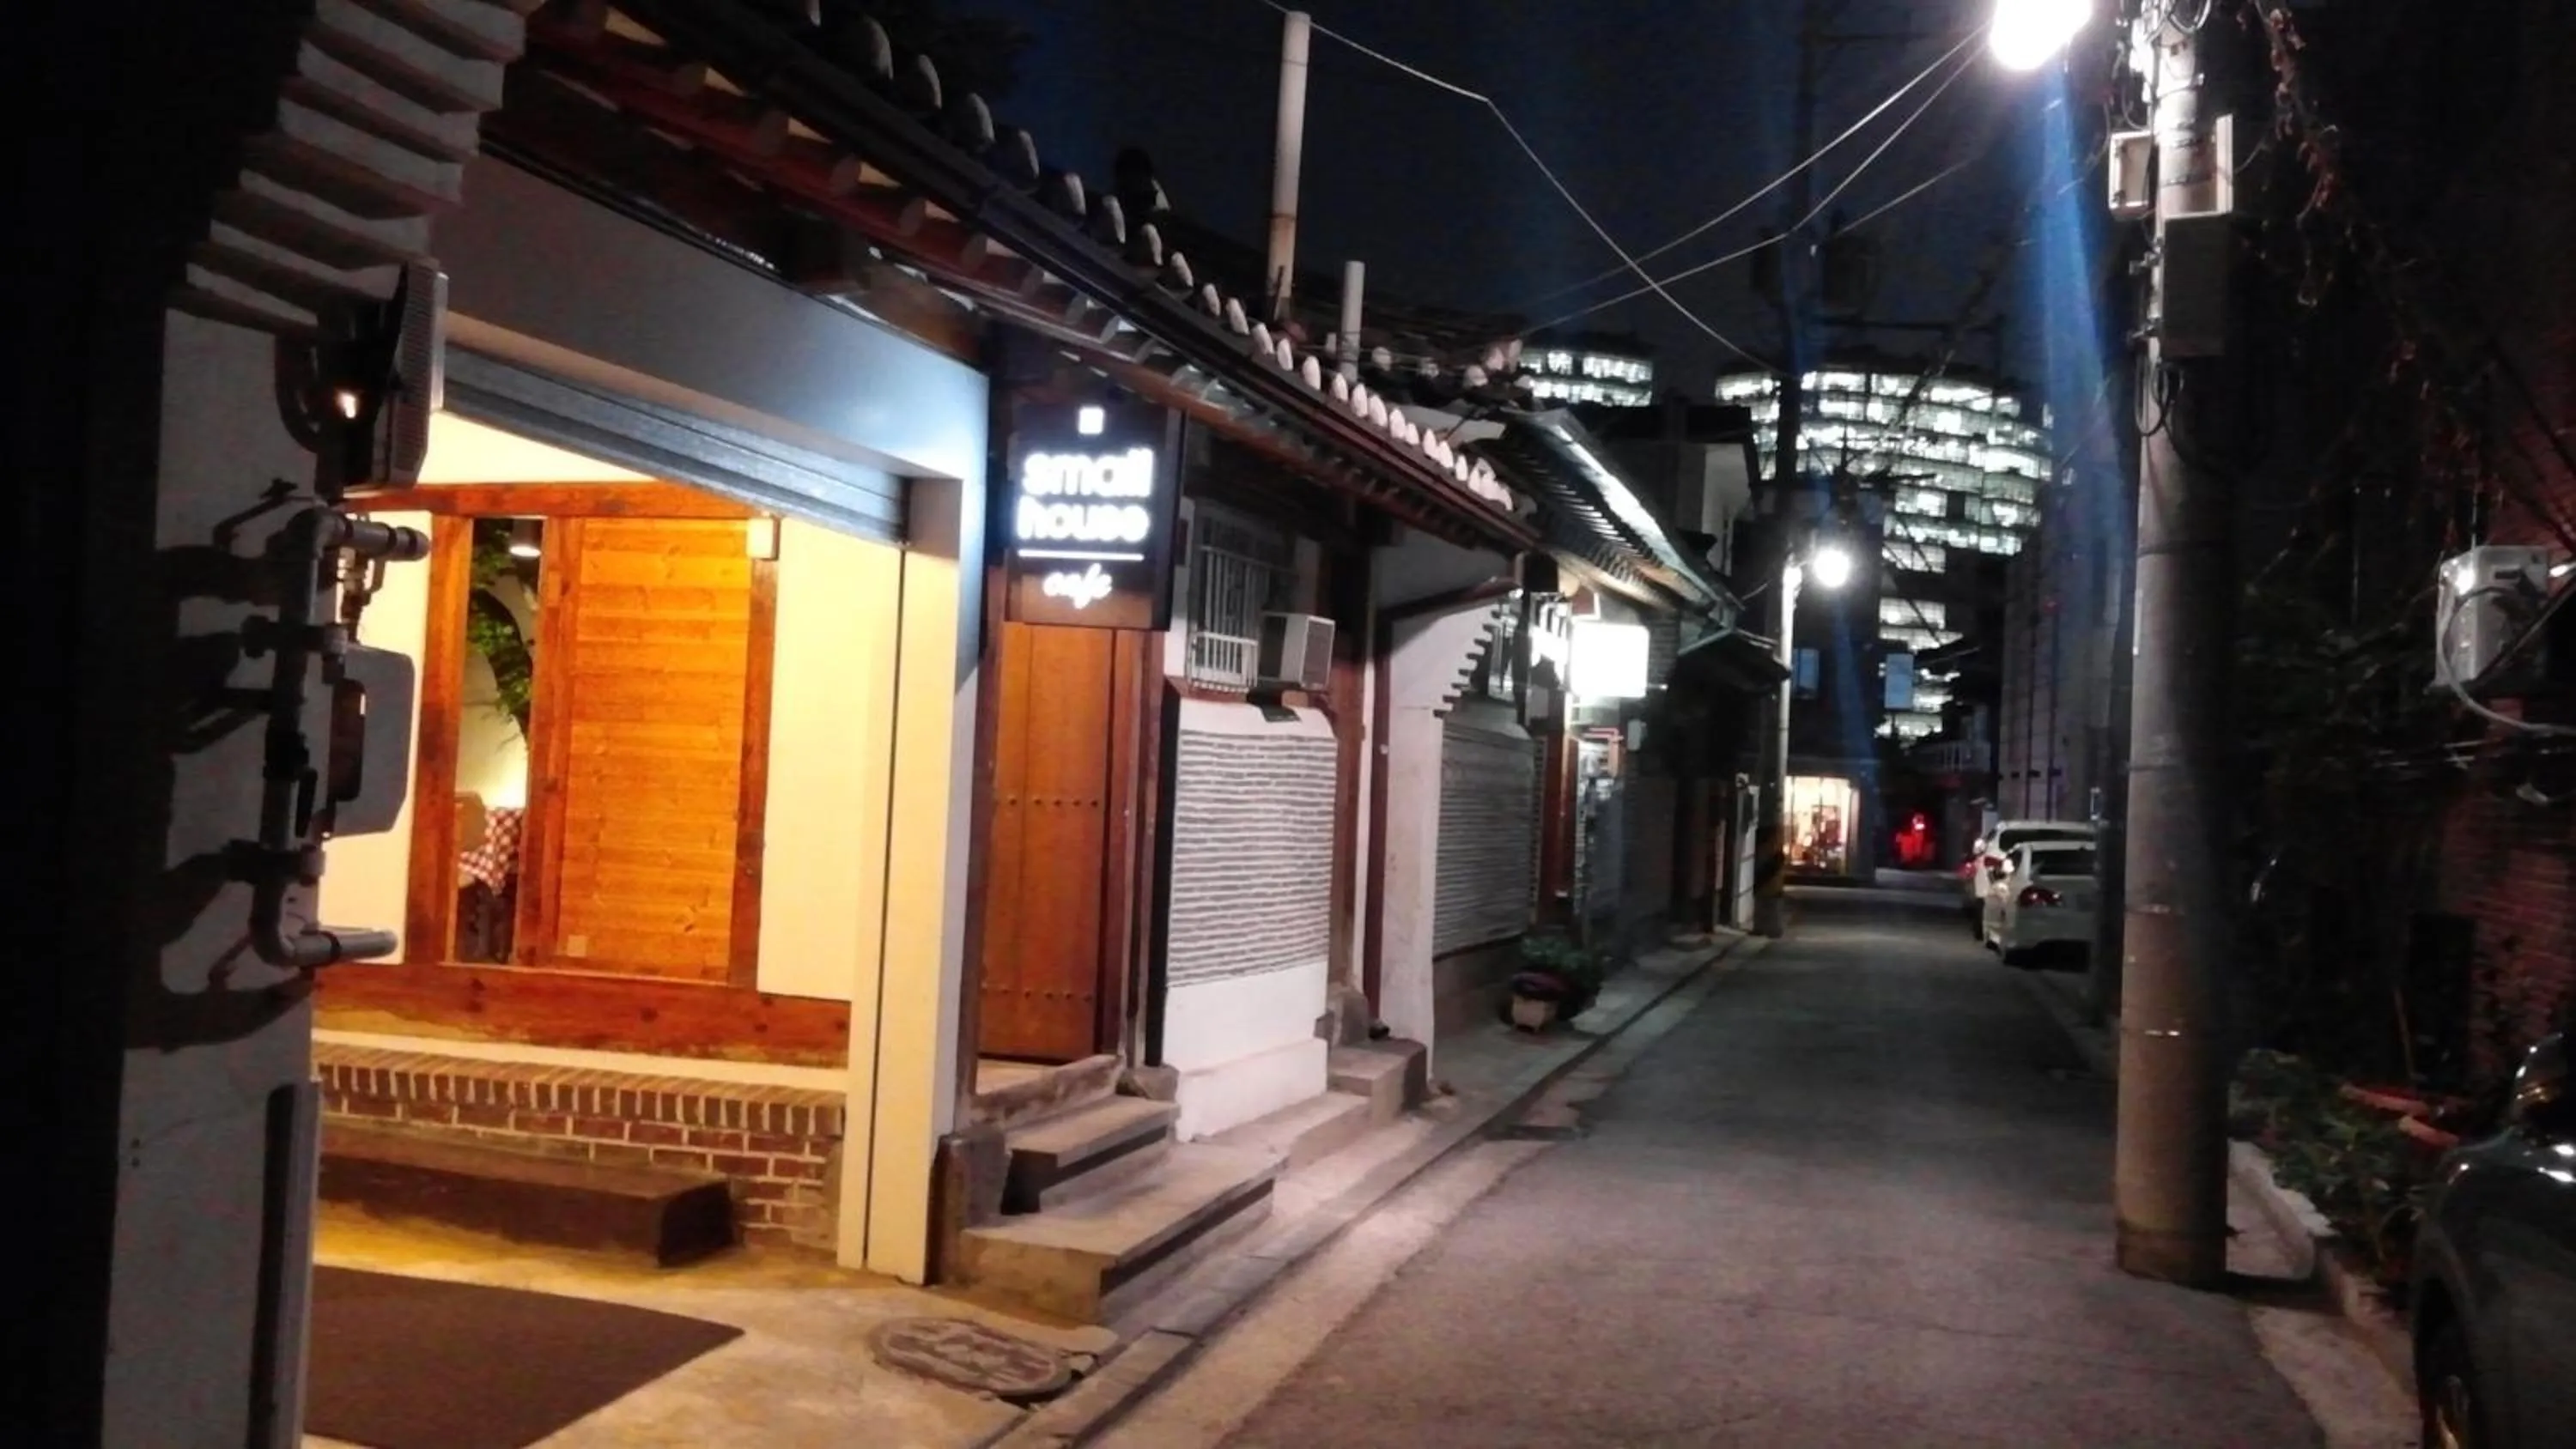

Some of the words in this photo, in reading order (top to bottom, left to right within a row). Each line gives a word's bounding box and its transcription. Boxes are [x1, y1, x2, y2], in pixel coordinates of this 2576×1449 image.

[1022, 447, 1153, 497] small
[1017, 494, 1150, 543] house
[1042, 562, 1112, 609] cafe
